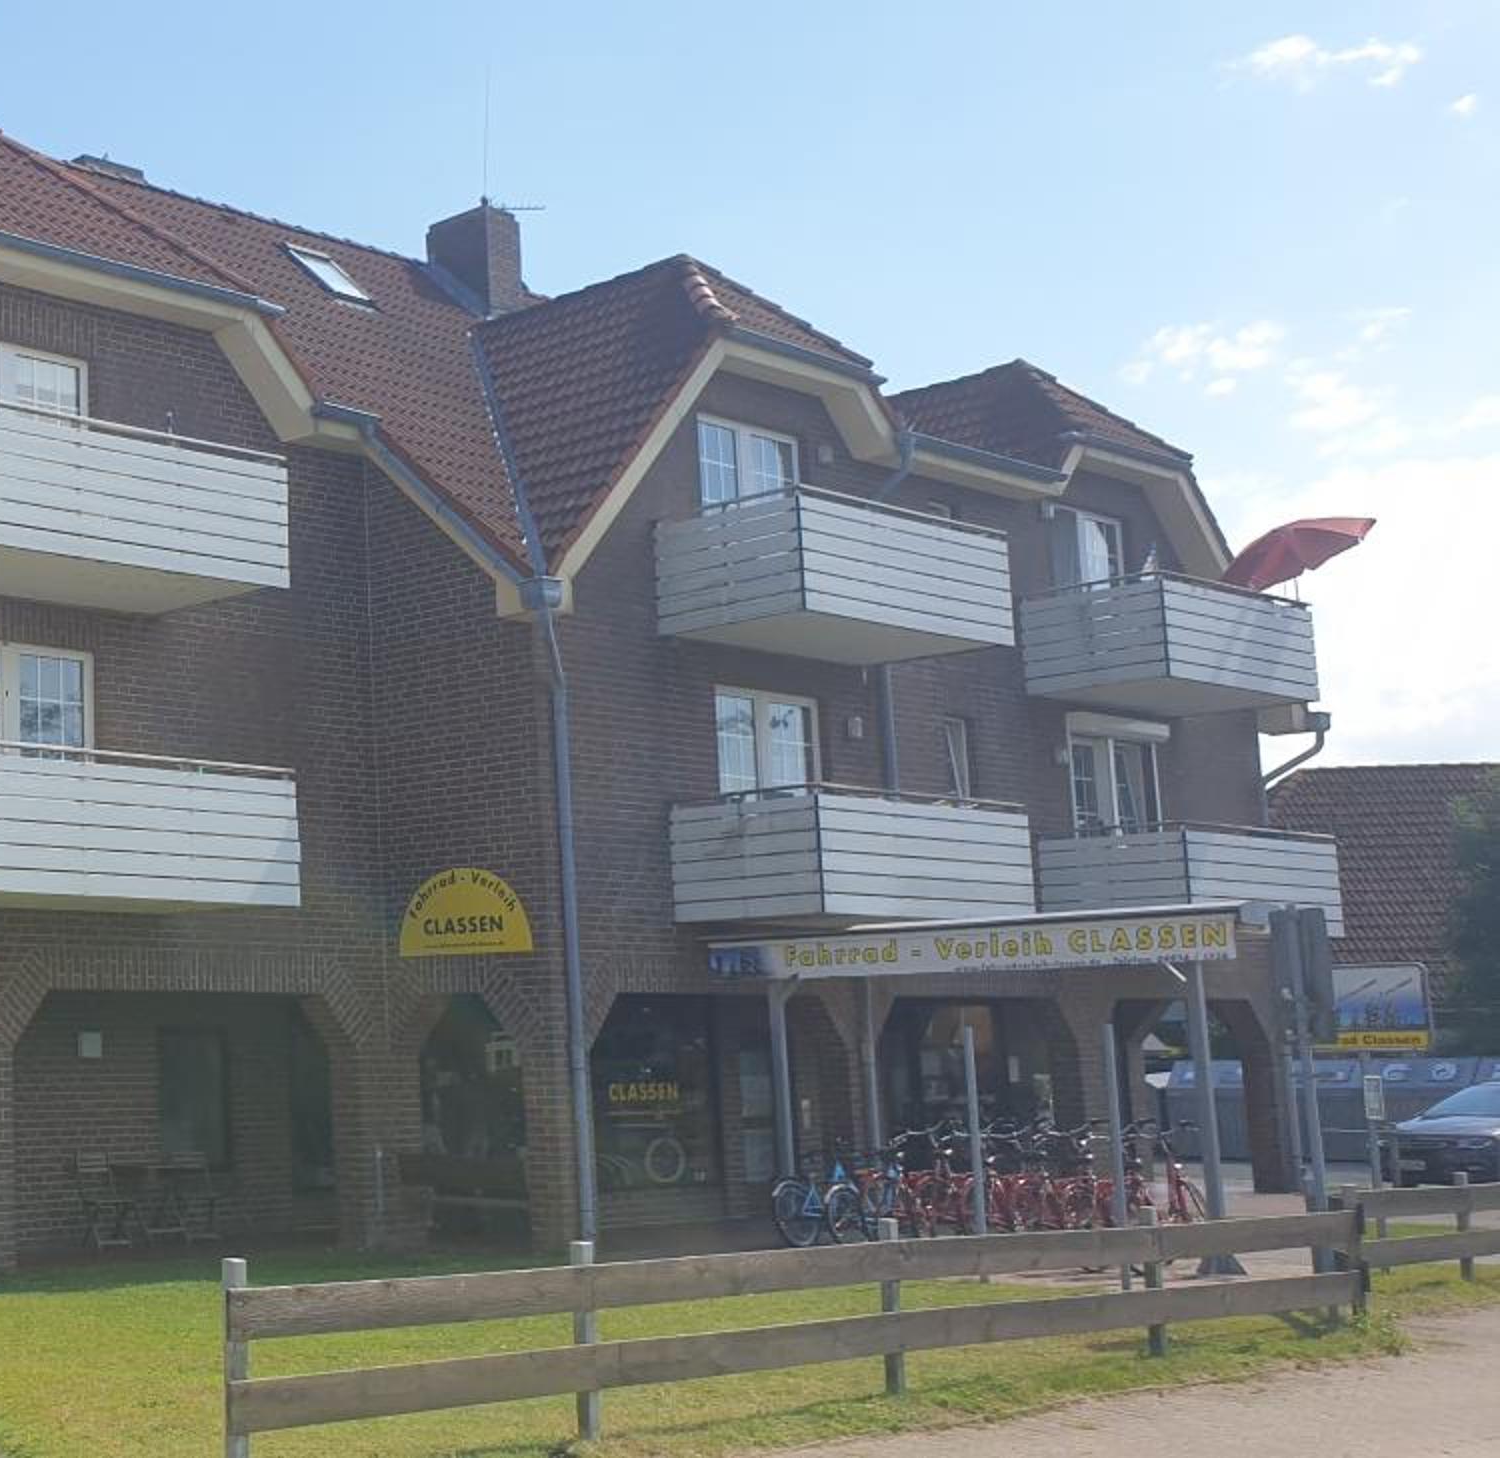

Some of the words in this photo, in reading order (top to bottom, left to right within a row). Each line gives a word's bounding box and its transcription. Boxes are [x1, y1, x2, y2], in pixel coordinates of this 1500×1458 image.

[408, 870, 455, 919] Fahrrad
[470, 870, 517, 912] Verleih
[423, 914, 504, 936] CLASSEN
[784, 937, 899, 968] Fahrrad
[934, 927, 1053, 960] Verleih
[1067, 922, 1228, 954] CLASSEN
[608, 1081, 679, 1103] CLASSEN
